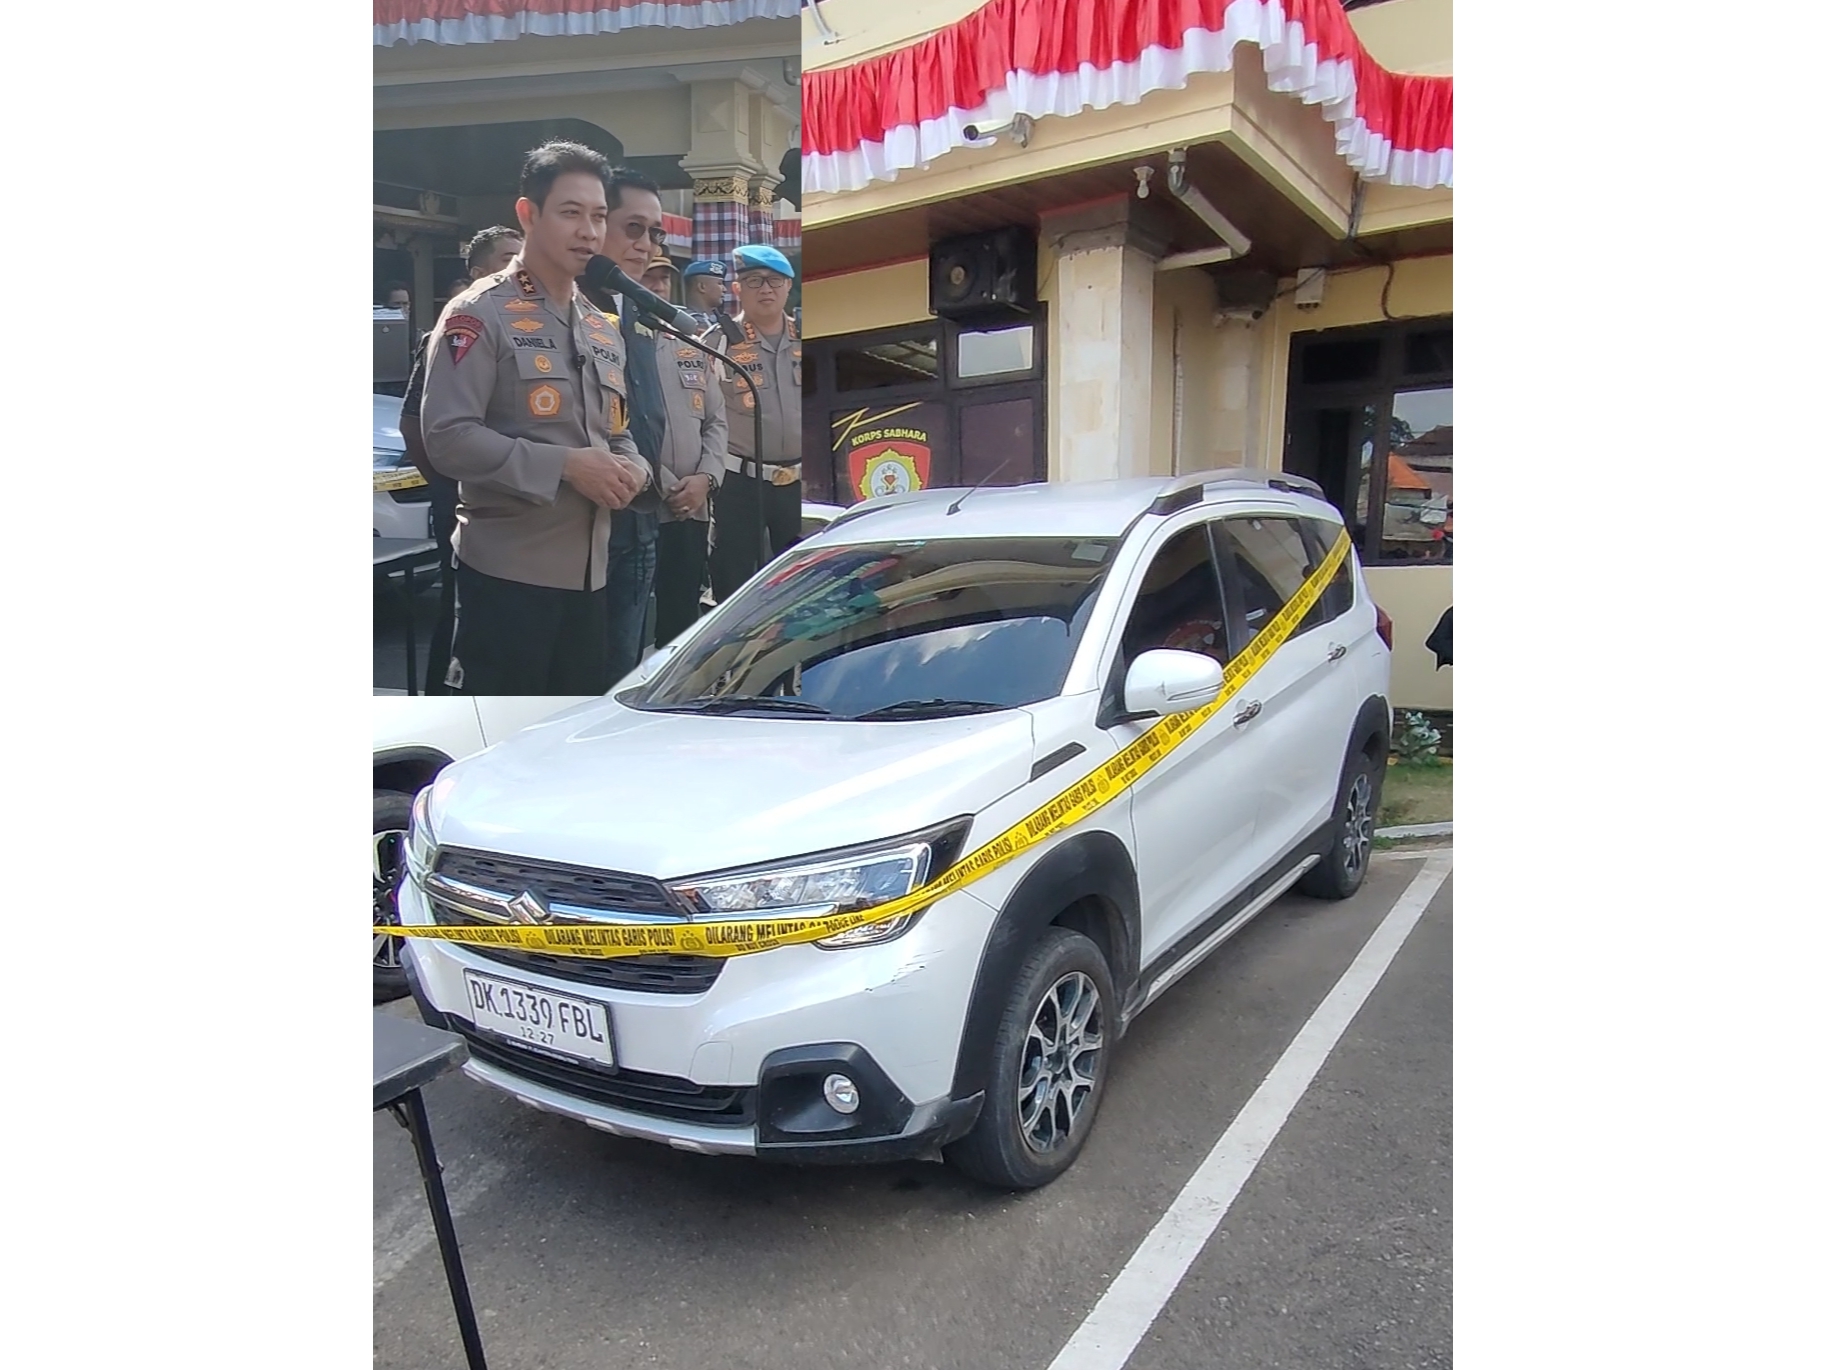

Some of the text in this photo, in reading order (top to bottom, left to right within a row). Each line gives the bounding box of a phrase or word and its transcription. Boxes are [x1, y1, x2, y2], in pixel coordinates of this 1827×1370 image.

[512, 336, 558, 350] DANIELA
[591, 345, 621, 367] POLRI
[851, 428, 927, 446] KORPS SABHARA
[543, 928, 677, 946] DILARANG MELINTAS GARIS POLISI
[705, 924, 754, 944] DILARANG
[470, 979, 604, 1044] DK 1339 FBL
